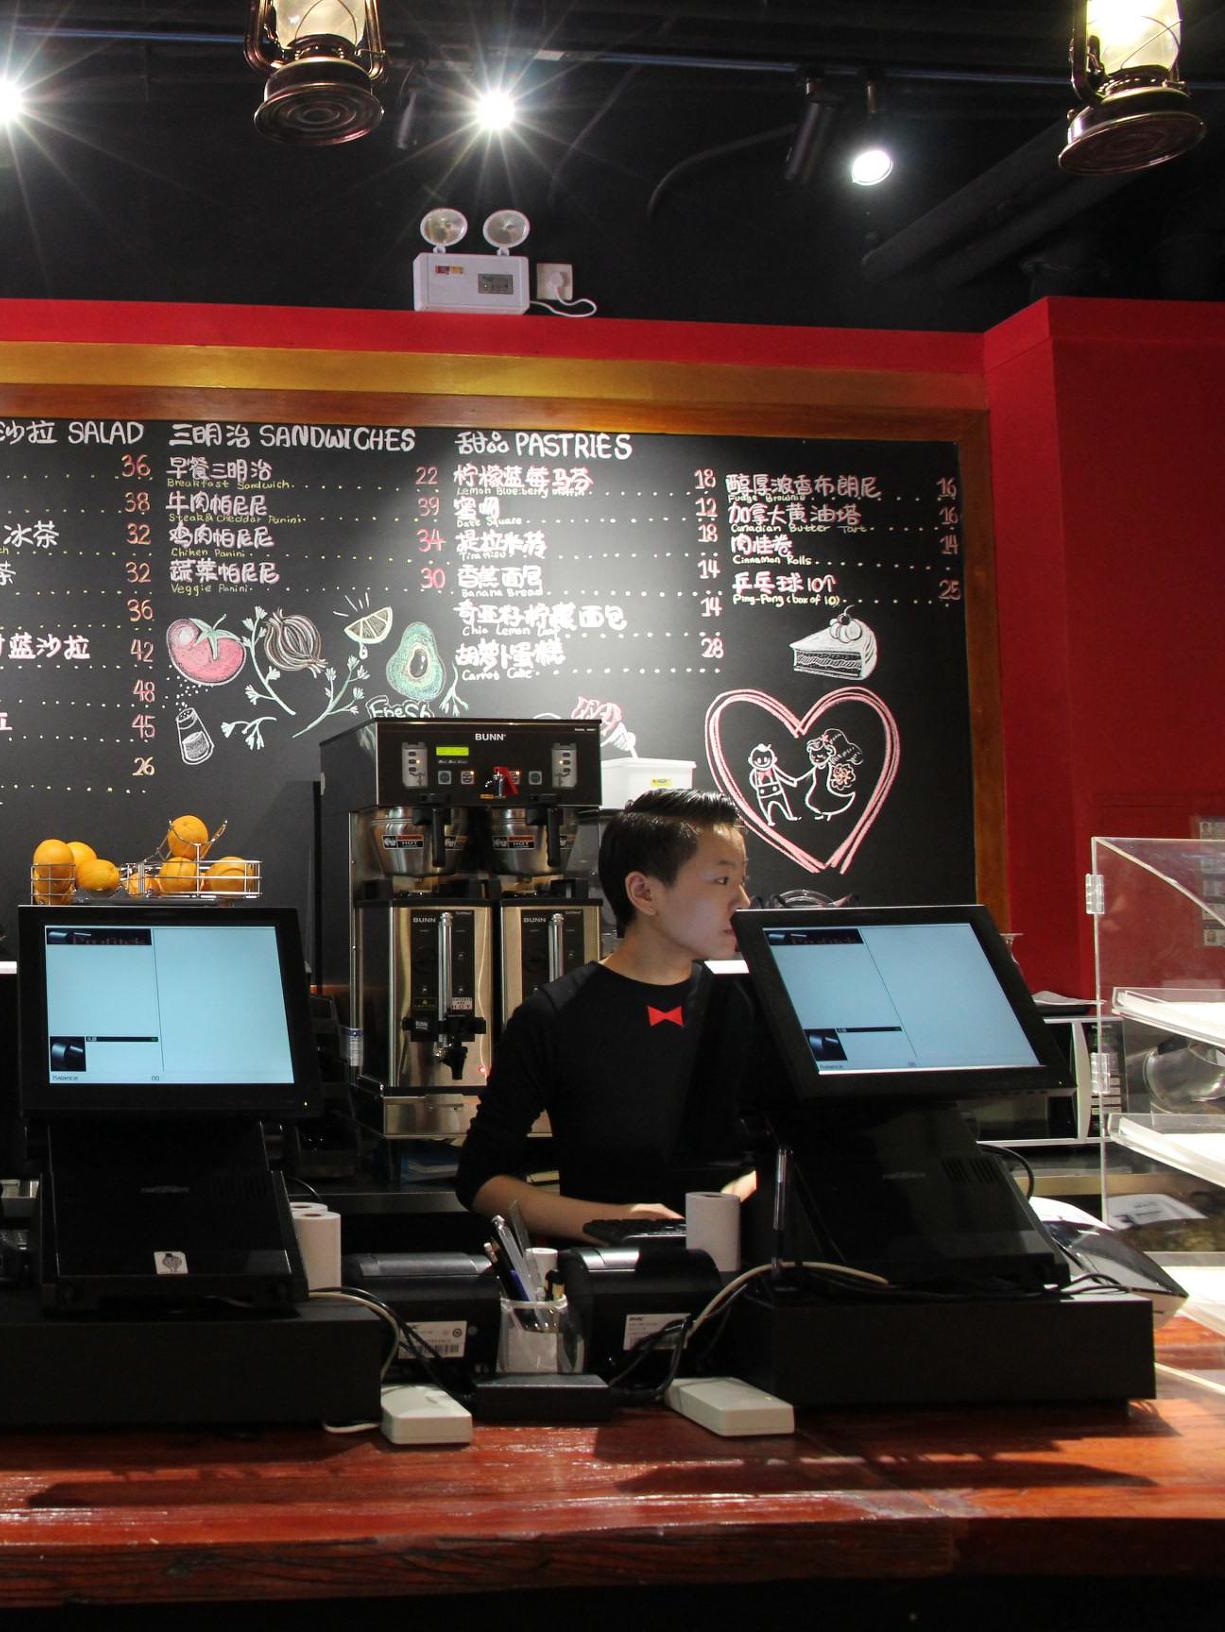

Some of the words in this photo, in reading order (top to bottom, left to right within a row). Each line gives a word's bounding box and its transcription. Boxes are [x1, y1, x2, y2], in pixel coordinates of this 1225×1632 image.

[67, 421, 144, 445] SALAD
[168, 423, 250, 448] 三明治
[260, 425, 416, 452] SANDWICHES
[455, 431, 510, 455] 甜品
[516, 432, 633, 460] PASTRIES
[121, 454, 152, 477] 36
[165, 456, 273, 483] 早餐三明治
[415, 467, 438, 485] 22
[693, 468, 717, 490] 18
[936, 476, 957, 498] 16
[124, 491, 151, 513] 38
[165, 490, 268, 517] 牛肉帕尼尼
[417, 496, 440, 518] 39
[694, 498, 719, 517] 12
[727, 501, 862, 526] 加拿大黄油塔
[938, 506, 959, 525] 16
[126, 523, 152, 546] 32
[168, 519, 275, 549] 鸡肉帕尼尼
[416, 528, 446, 553] 34
[697, 523, 719, 543] 18
[938, 533, 959, 555] 14
[125, 561, 152, 584] 32
[169, 557, 281, 585] 蔬菜帕尼尼
[420, 567, 446, 590] 30
[696, 559, 721, 579] 14
[938, 579, 961, 601] 25
[127, 598, 154, 622] 36
[700, 596, 723, 617] 14
[130, 639, 154, 663] 42
[700, 637, 724, 659] 28
[133, 679, 156, 703] 48
[131, 714, 156, 739] 45
[132, 757, 155, 777] 26
[412, 916, 437, 924] BUNN
